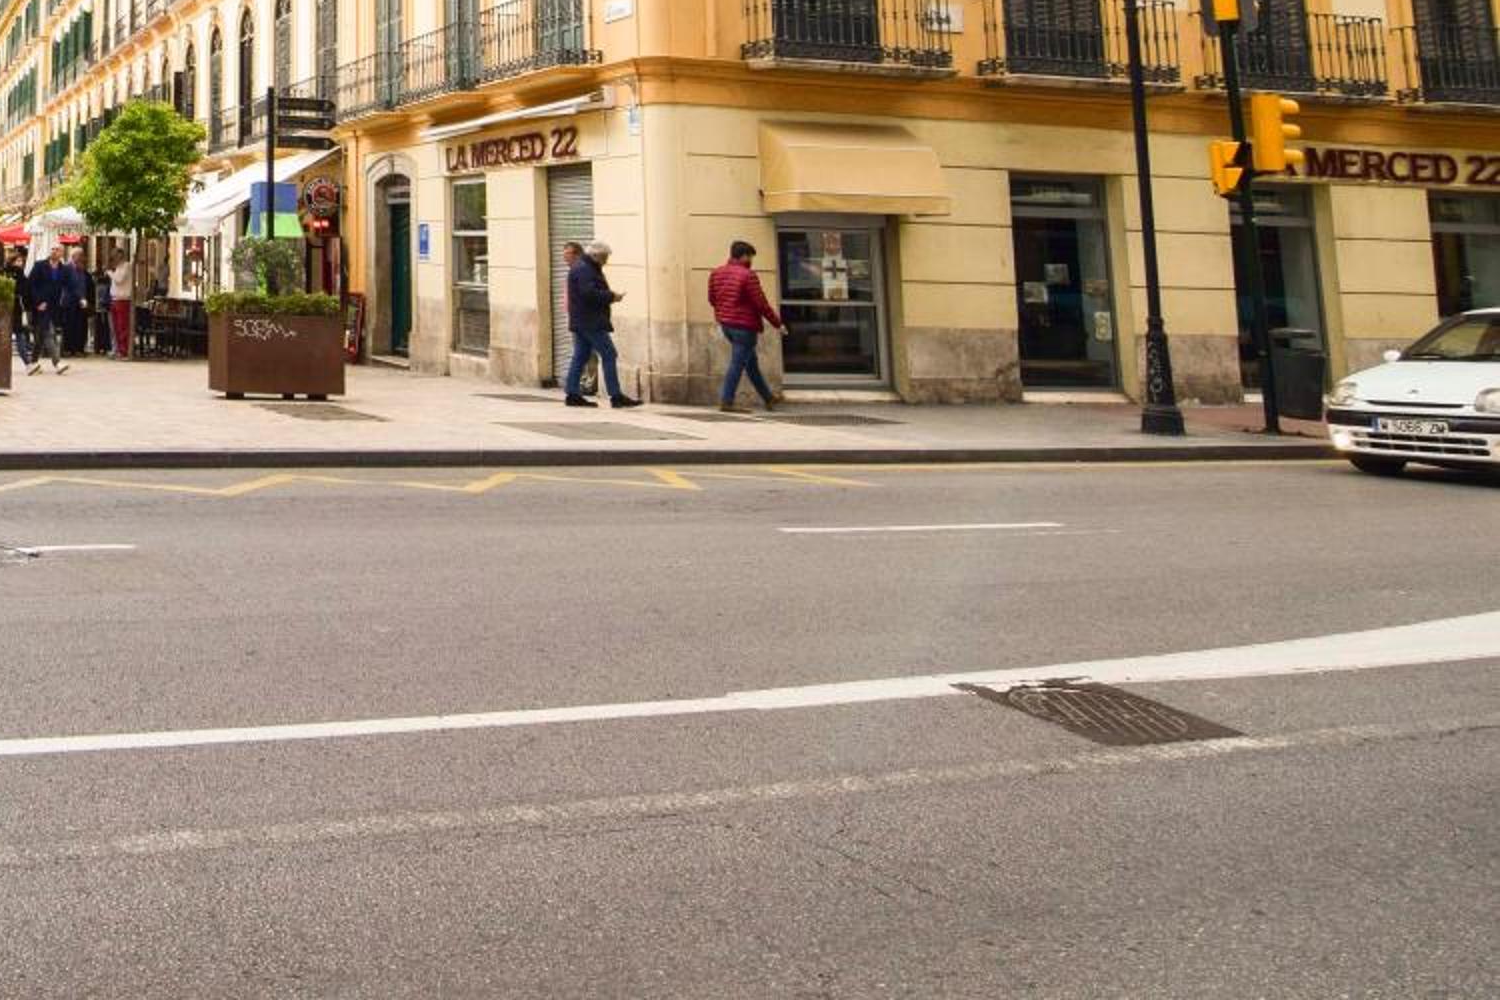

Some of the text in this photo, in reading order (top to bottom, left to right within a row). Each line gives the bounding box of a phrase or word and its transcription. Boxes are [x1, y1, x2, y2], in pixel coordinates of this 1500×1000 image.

[446, 126, 578, 172] LA MERCED 22
[1303, 147, 1459, 184] MERCED
